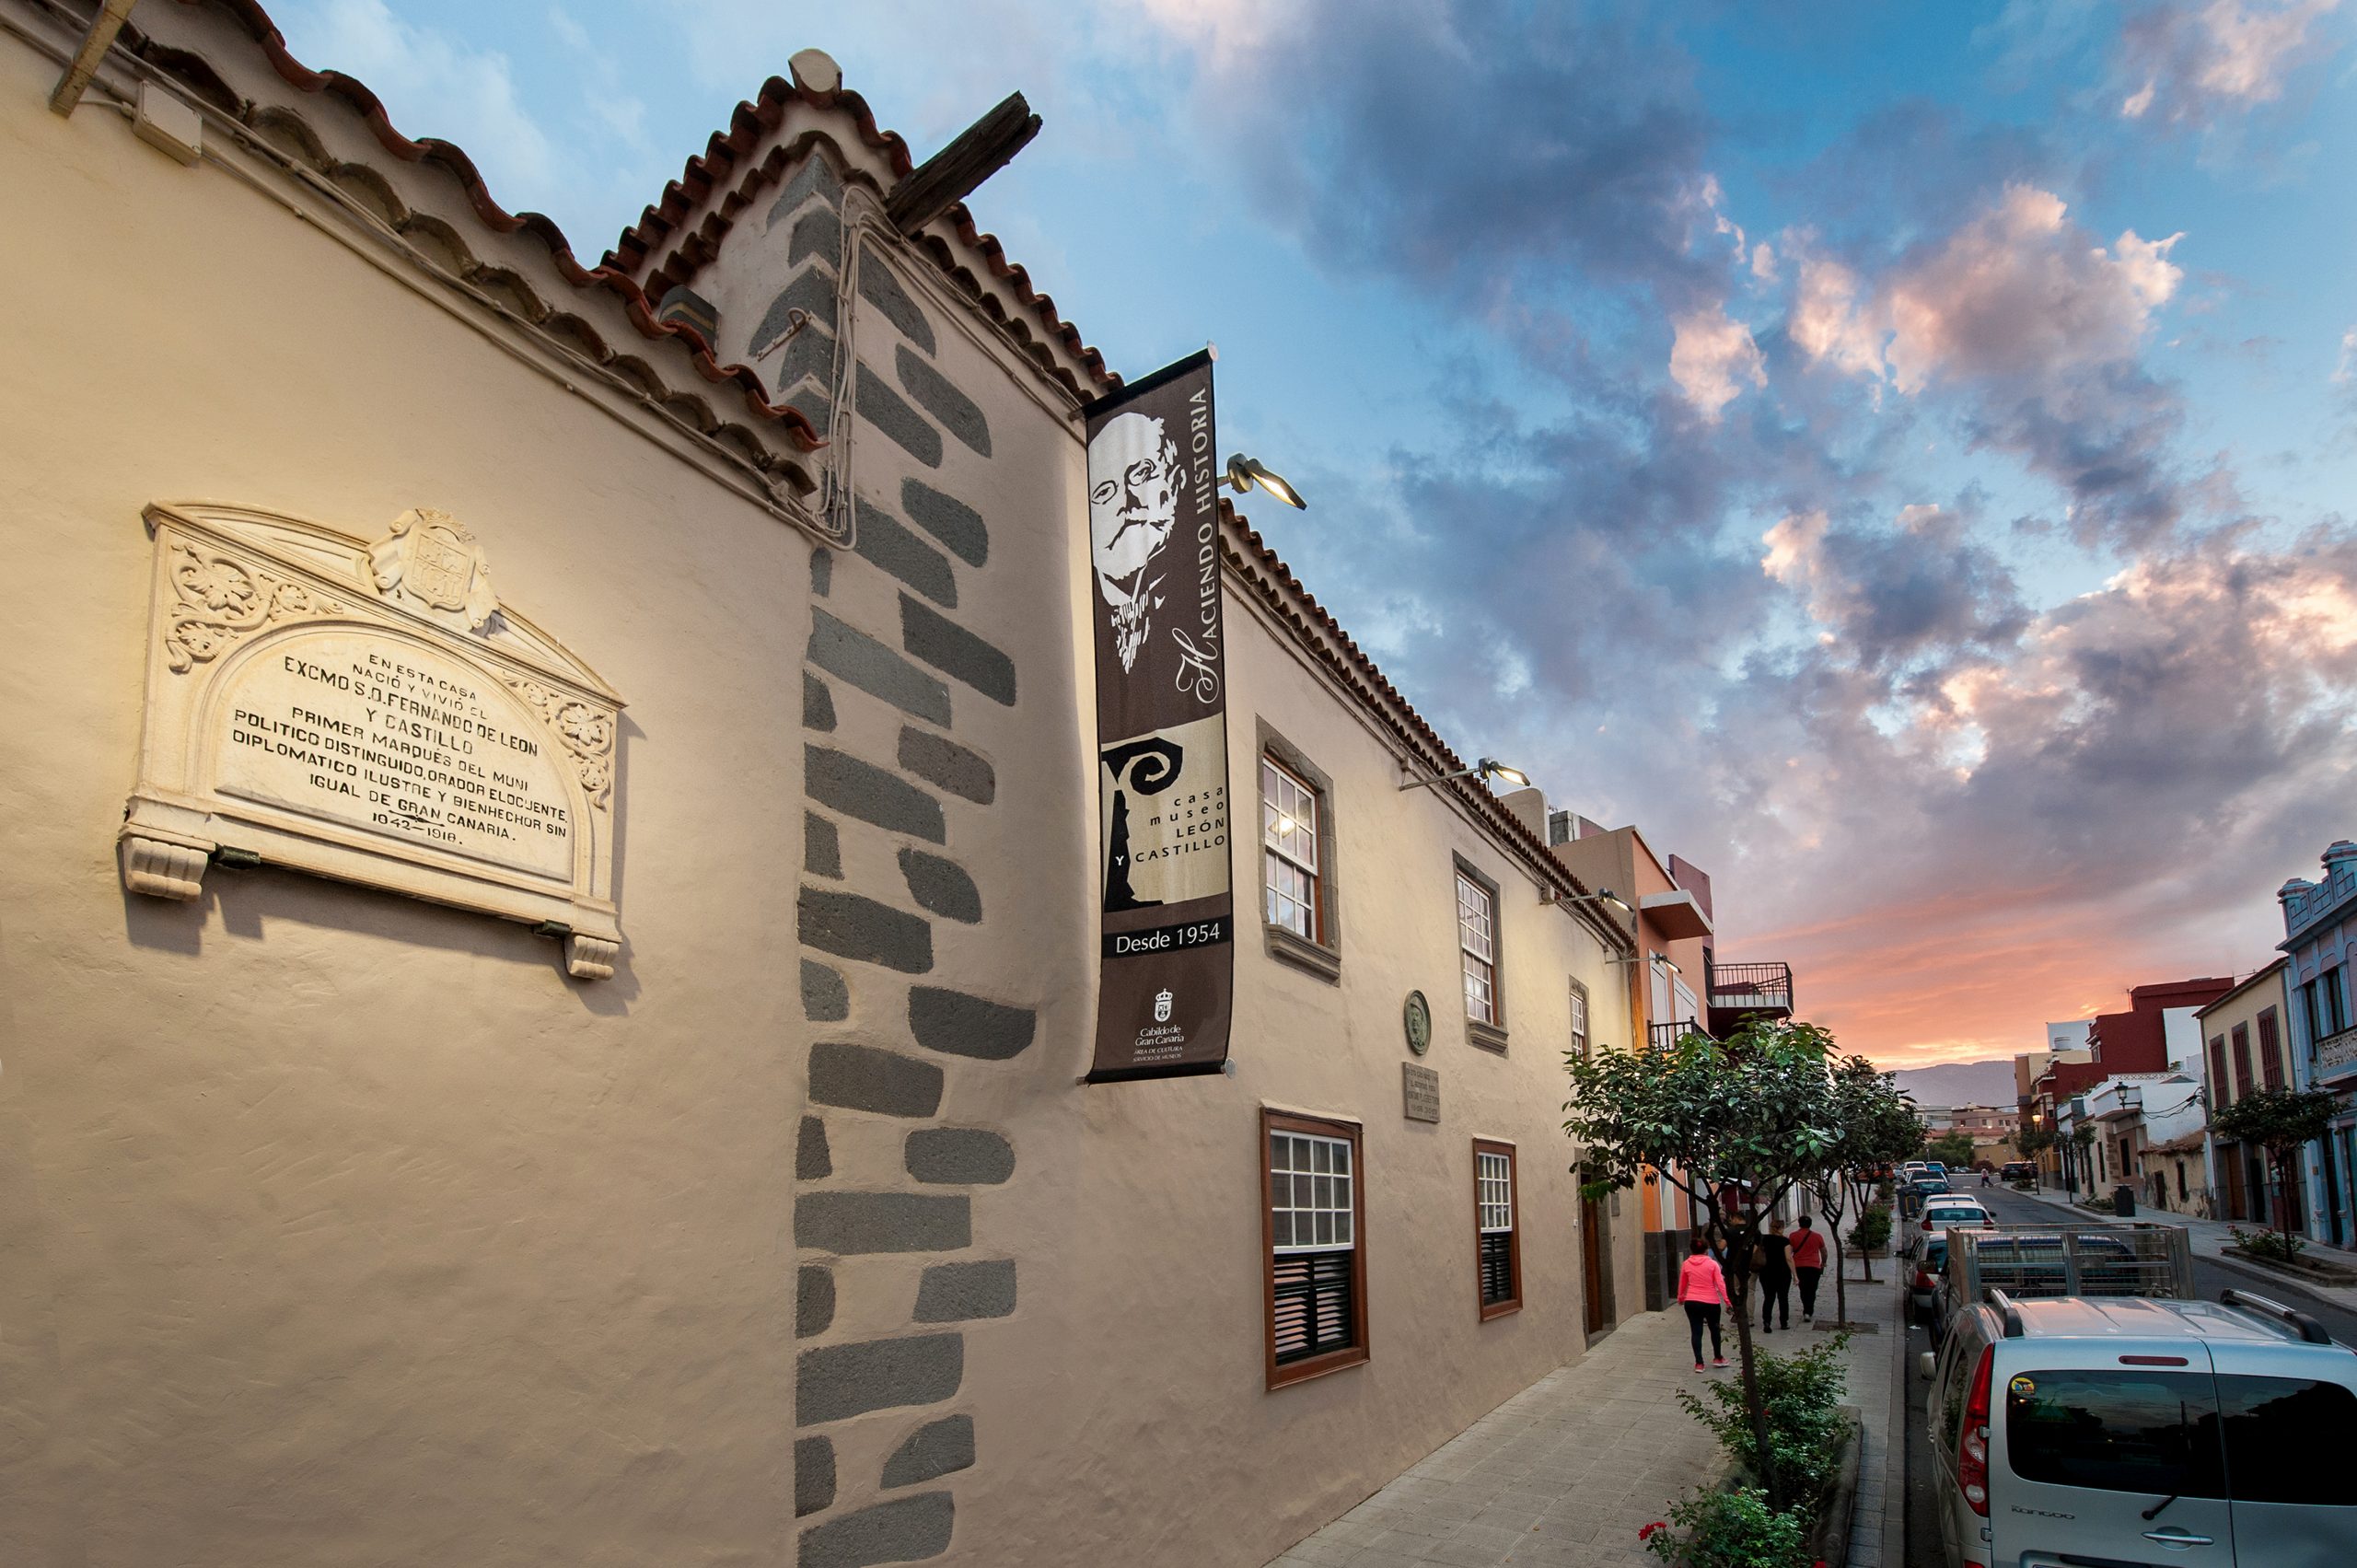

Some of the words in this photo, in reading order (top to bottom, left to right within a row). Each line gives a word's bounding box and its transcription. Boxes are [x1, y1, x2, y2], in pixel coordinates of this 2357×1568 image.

[1190, 387, 1212, 515] HISTORIA
[353, 663, 401, 689] NACIÓ
[408, 684, 415, 693] Y
[423, 689, 463, 711] VIVIÓ
[470, 707, 488, 720] EL
[369, 654, 391, 669] EN
[397, 665, 435, 685] ESTA
[439, 679, 477, 701] CASA
[284, 656, 349, 691] EXCMO
[477, 724, 496, 743] DE
[501, 732, 538, 757] LEON
[235, 709, 319, 747] POLITICO
[366, 707, 377, 723] Y
[386, 714, 473, 755] CASTILLO
[292, 706, 364, 739] PRIMER
[373, 732, 452, 767] MARQUÉS
[459, 761, 486, 779] DEL
[493, 771, 528, 792] MUNI
[232, 728, 357, 776] DIPLOMATICO
[365, 769, 431, 799] ILUSTRE
[437, 790, 447, 803] Y
[453, 795, 540, 830] BIENHECHOR
[546, 823, 566, 838] SIN
[310, 773, 361, 798] IGUAL
[369, 790, 390, 807] DE
[398, 798, 440, 819] GRAN
[1174, 786, 1223, 807] casa
[1150, 801, 1224, 826] museo
[1176, 817, 1225, 839] LEÓN
[1115, 855, 1125, 866] Y
[1135, 835, 1225, 863] CASTILLO
[1116, 930, 1171, 954] Desde
[1177, 923, 1220, 945] 1954
[1134, 1037, 1155, 1047] Gran
[1155, 1033, 1185, 1045] Canaria
[1140, 1026, 1169, 1037] Cabildo
[1169, 1024, 1181, 1034] de
[1156, 1045, 1183, 1053] CULTURA
